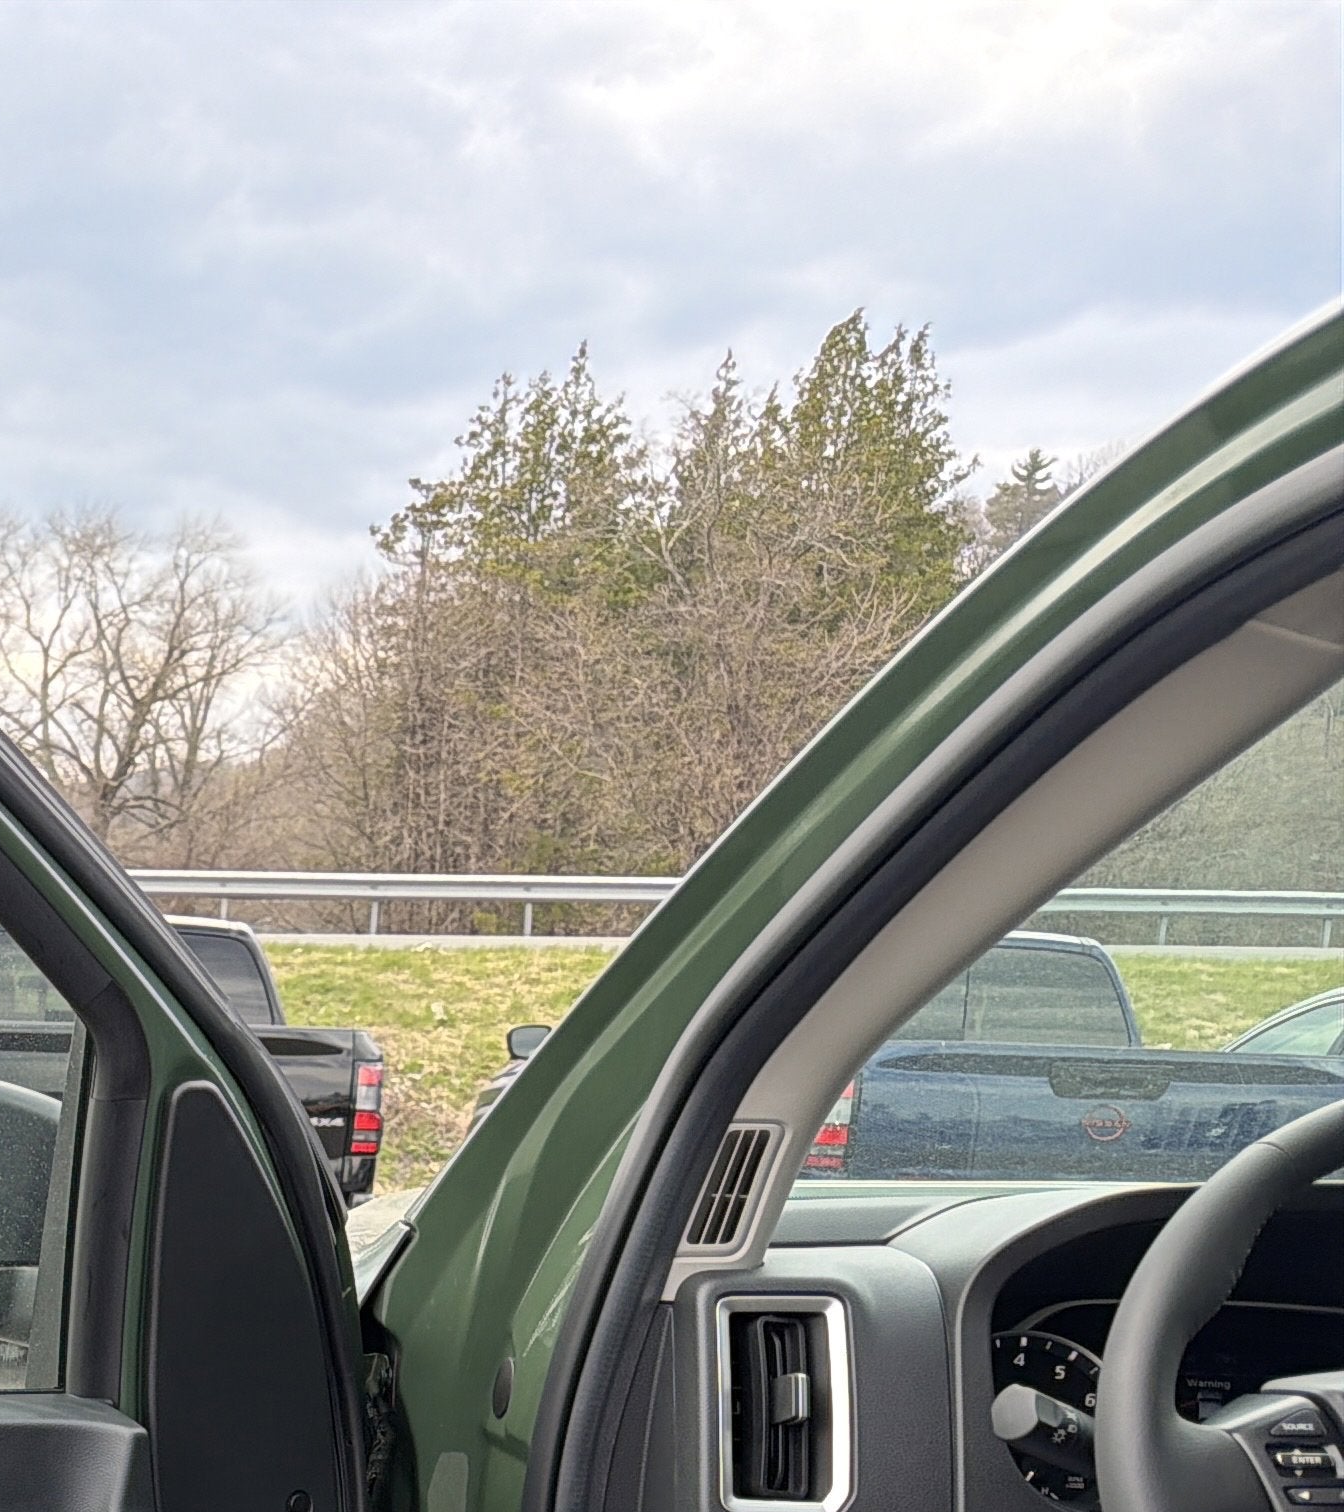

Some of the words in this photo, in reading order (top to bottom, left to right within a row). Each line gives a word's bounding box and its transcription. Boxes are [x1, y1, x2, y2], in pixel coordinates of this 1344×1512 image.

[1013, 1353, 1025, 1367] 4
[1054, 1365, 1066, 1380] 5
[1186, 1378, 1231, 1390] Warning
[1085, 1393, 1096, 1407] 6
[1282, 1422, 1314, 1431] SOURCE
[1291, 1455, 1322, 1465] ENTER
